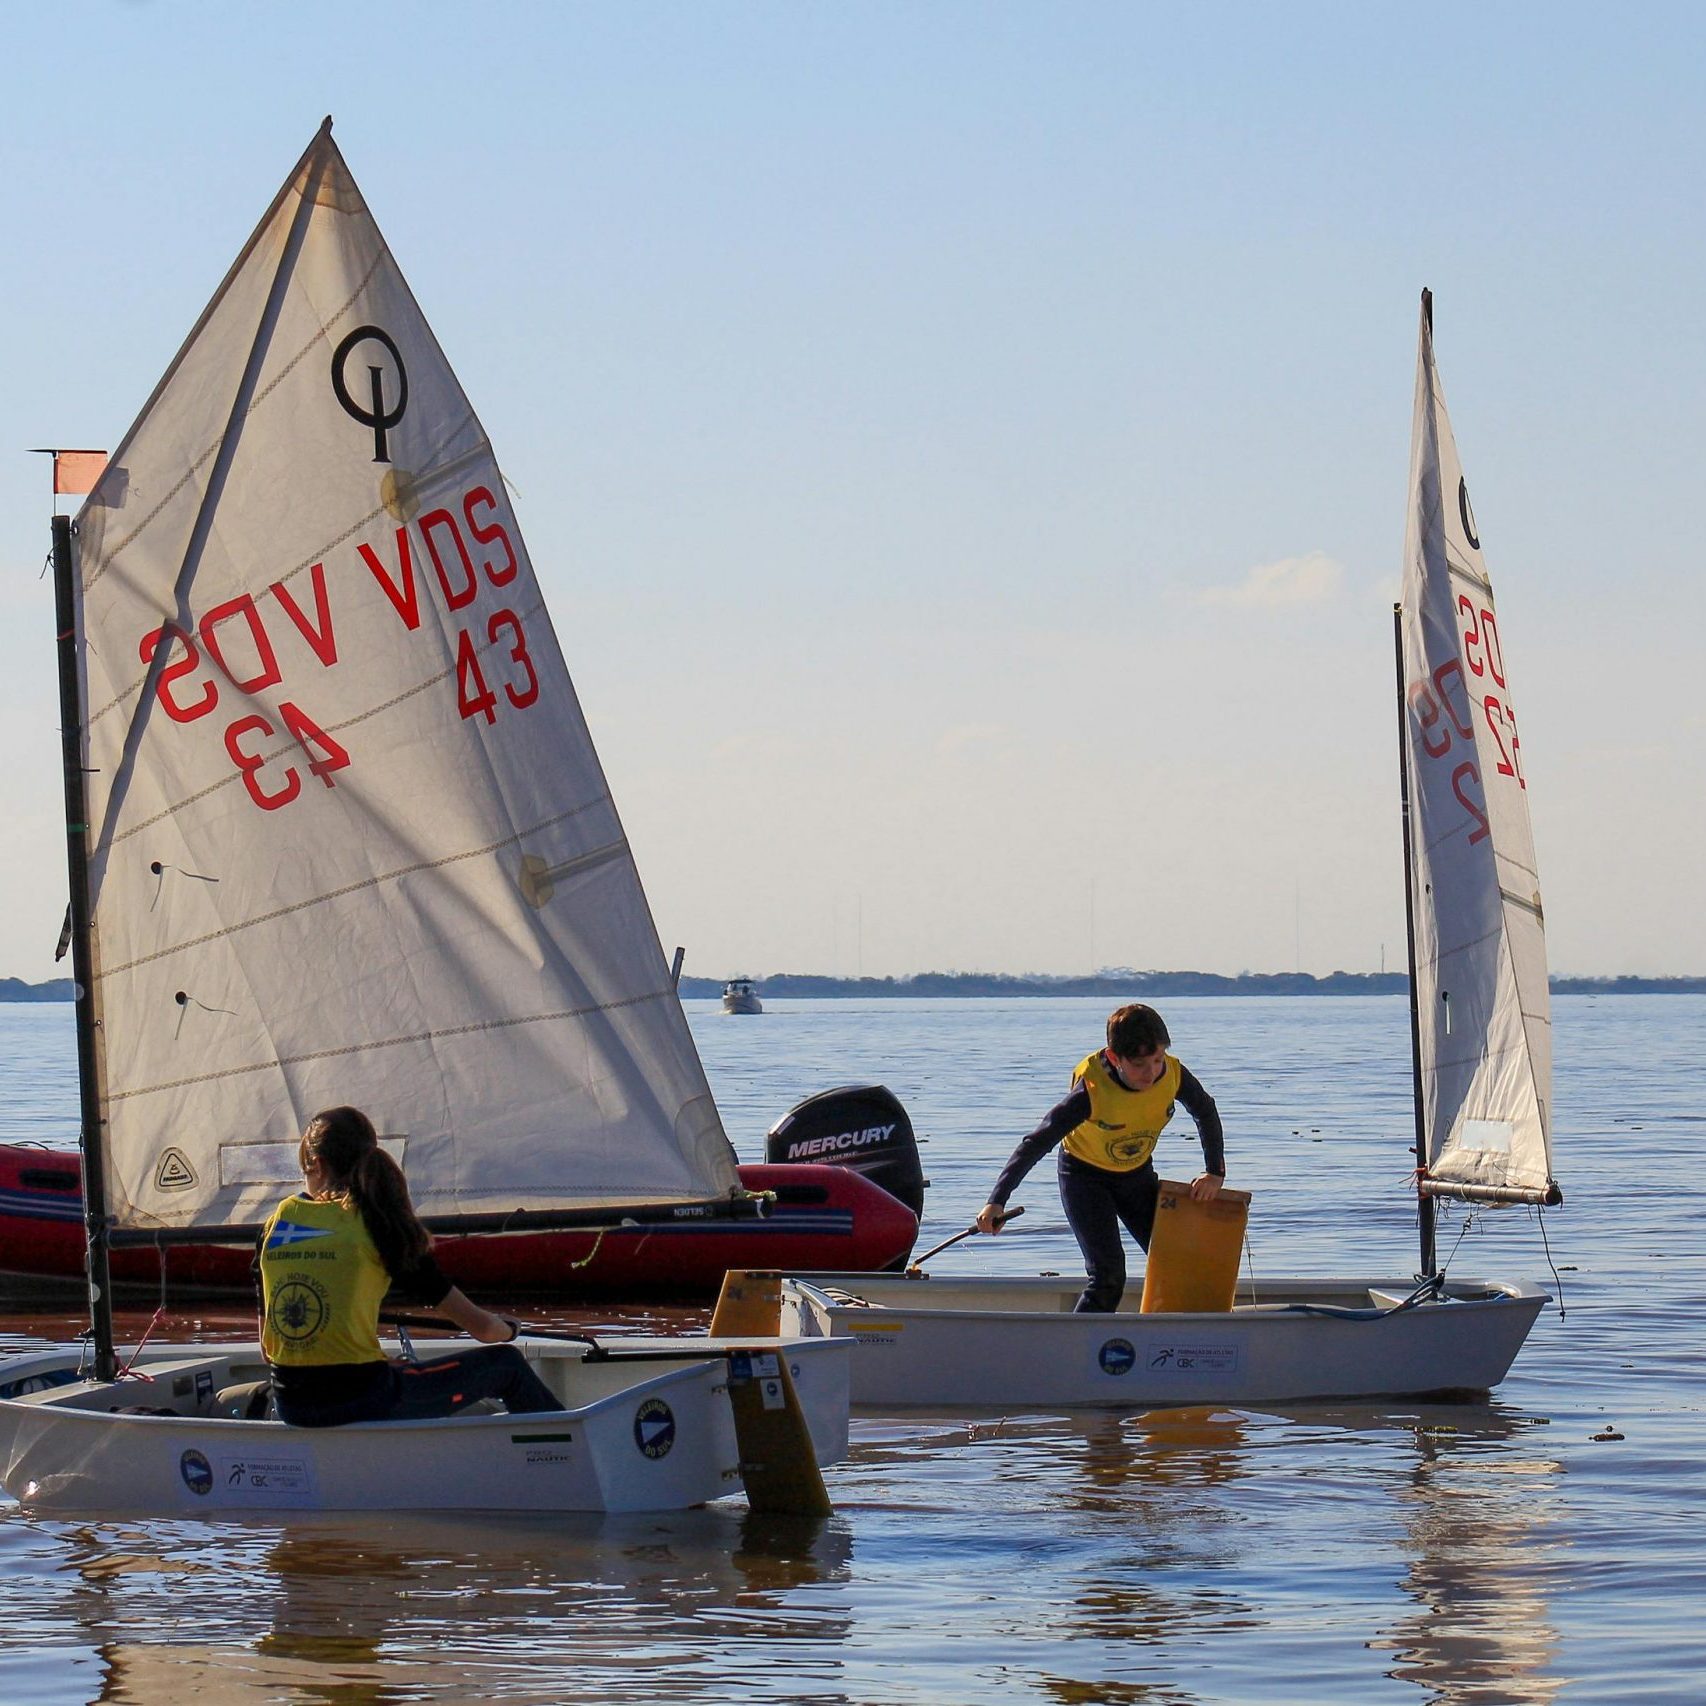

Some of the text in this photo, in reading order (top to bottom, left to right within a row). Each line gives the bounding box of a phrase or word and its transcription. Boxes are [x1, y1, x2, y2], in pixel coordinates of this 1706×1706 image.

[357, 486, 517, 630] VDS
[457, 609, 538, 726] 43
[787, 1124, 896, 1159] MERCURY
[304, 1250, 317, 1260] DO
[318, 1250, 337, 1260] SUL
